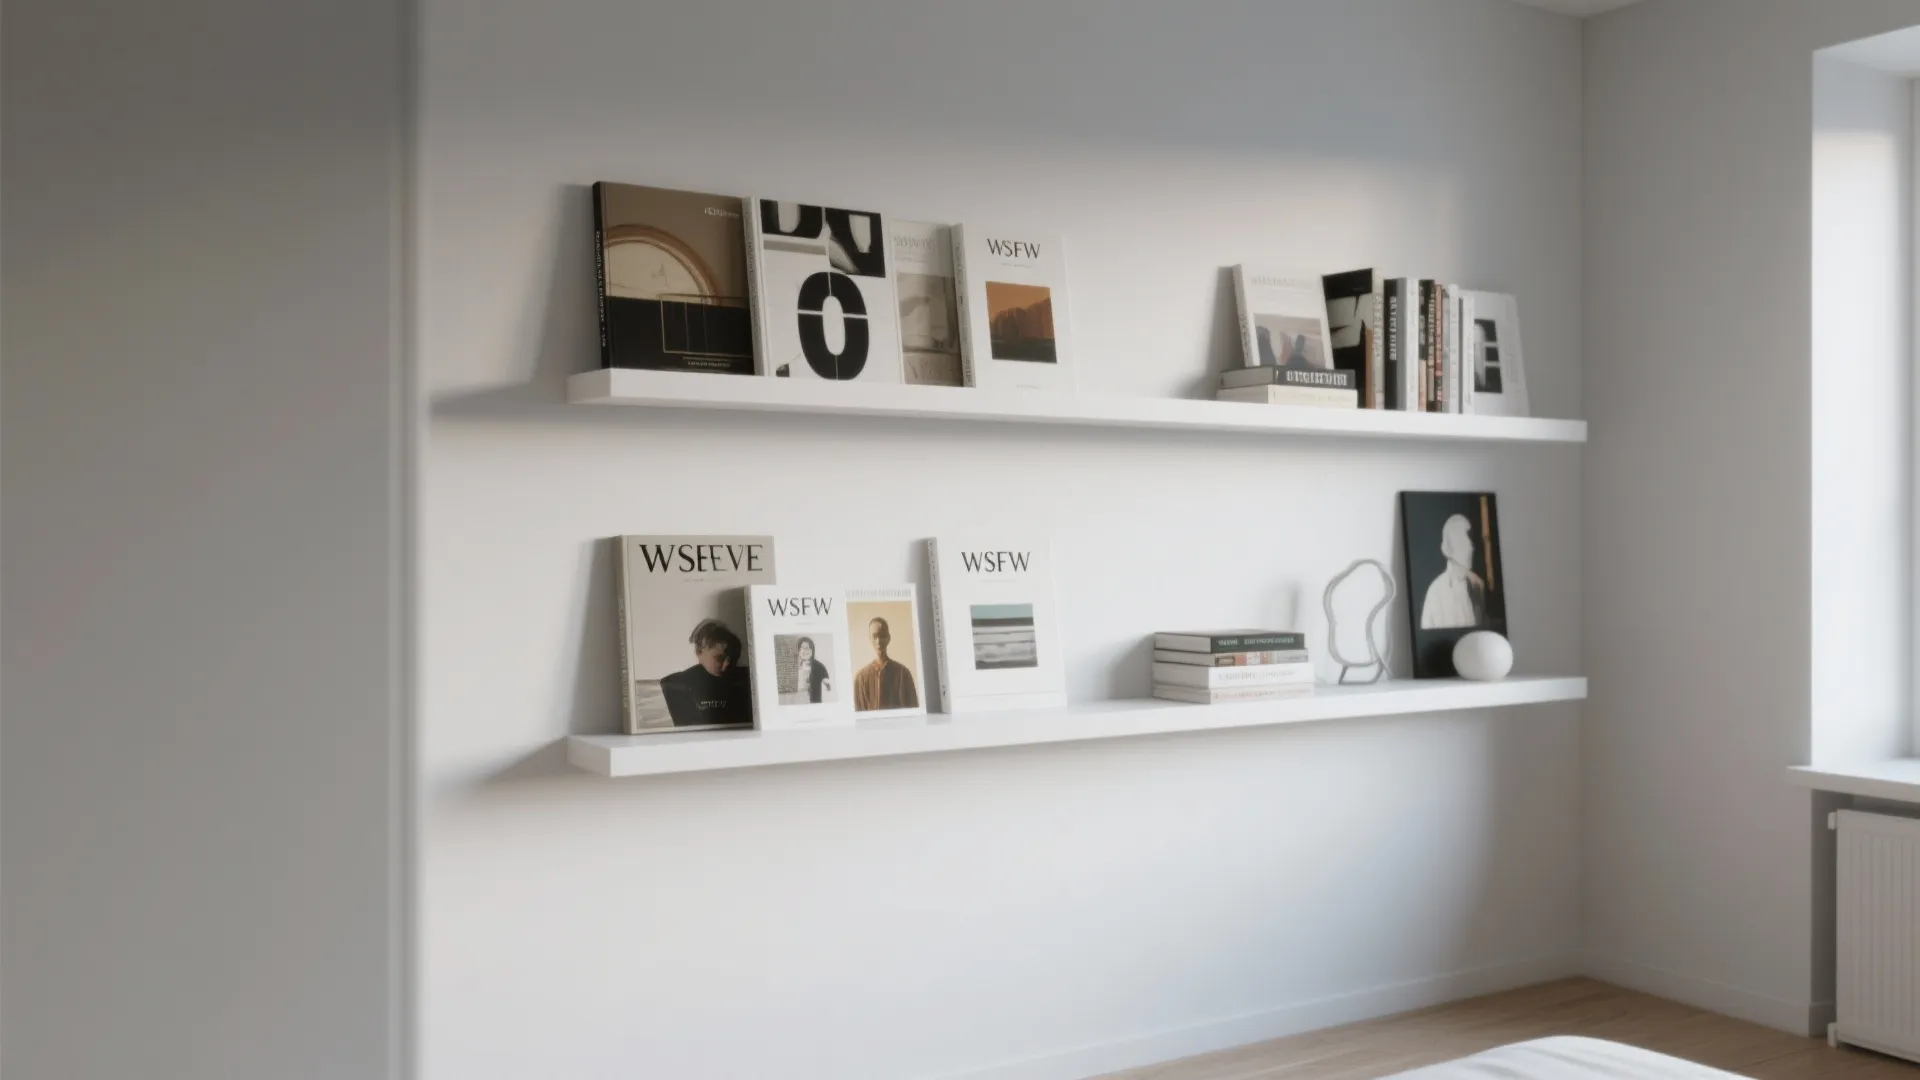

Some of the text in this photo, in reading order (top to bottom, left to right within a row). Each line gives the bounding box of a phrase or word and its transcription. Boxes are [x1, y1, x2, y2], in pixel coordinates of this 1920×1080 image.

[986, 238, 1041, 259] WSFW
[961, 551, 1030, 573] WSFW
[767, 597, 832, 617] WSFW
